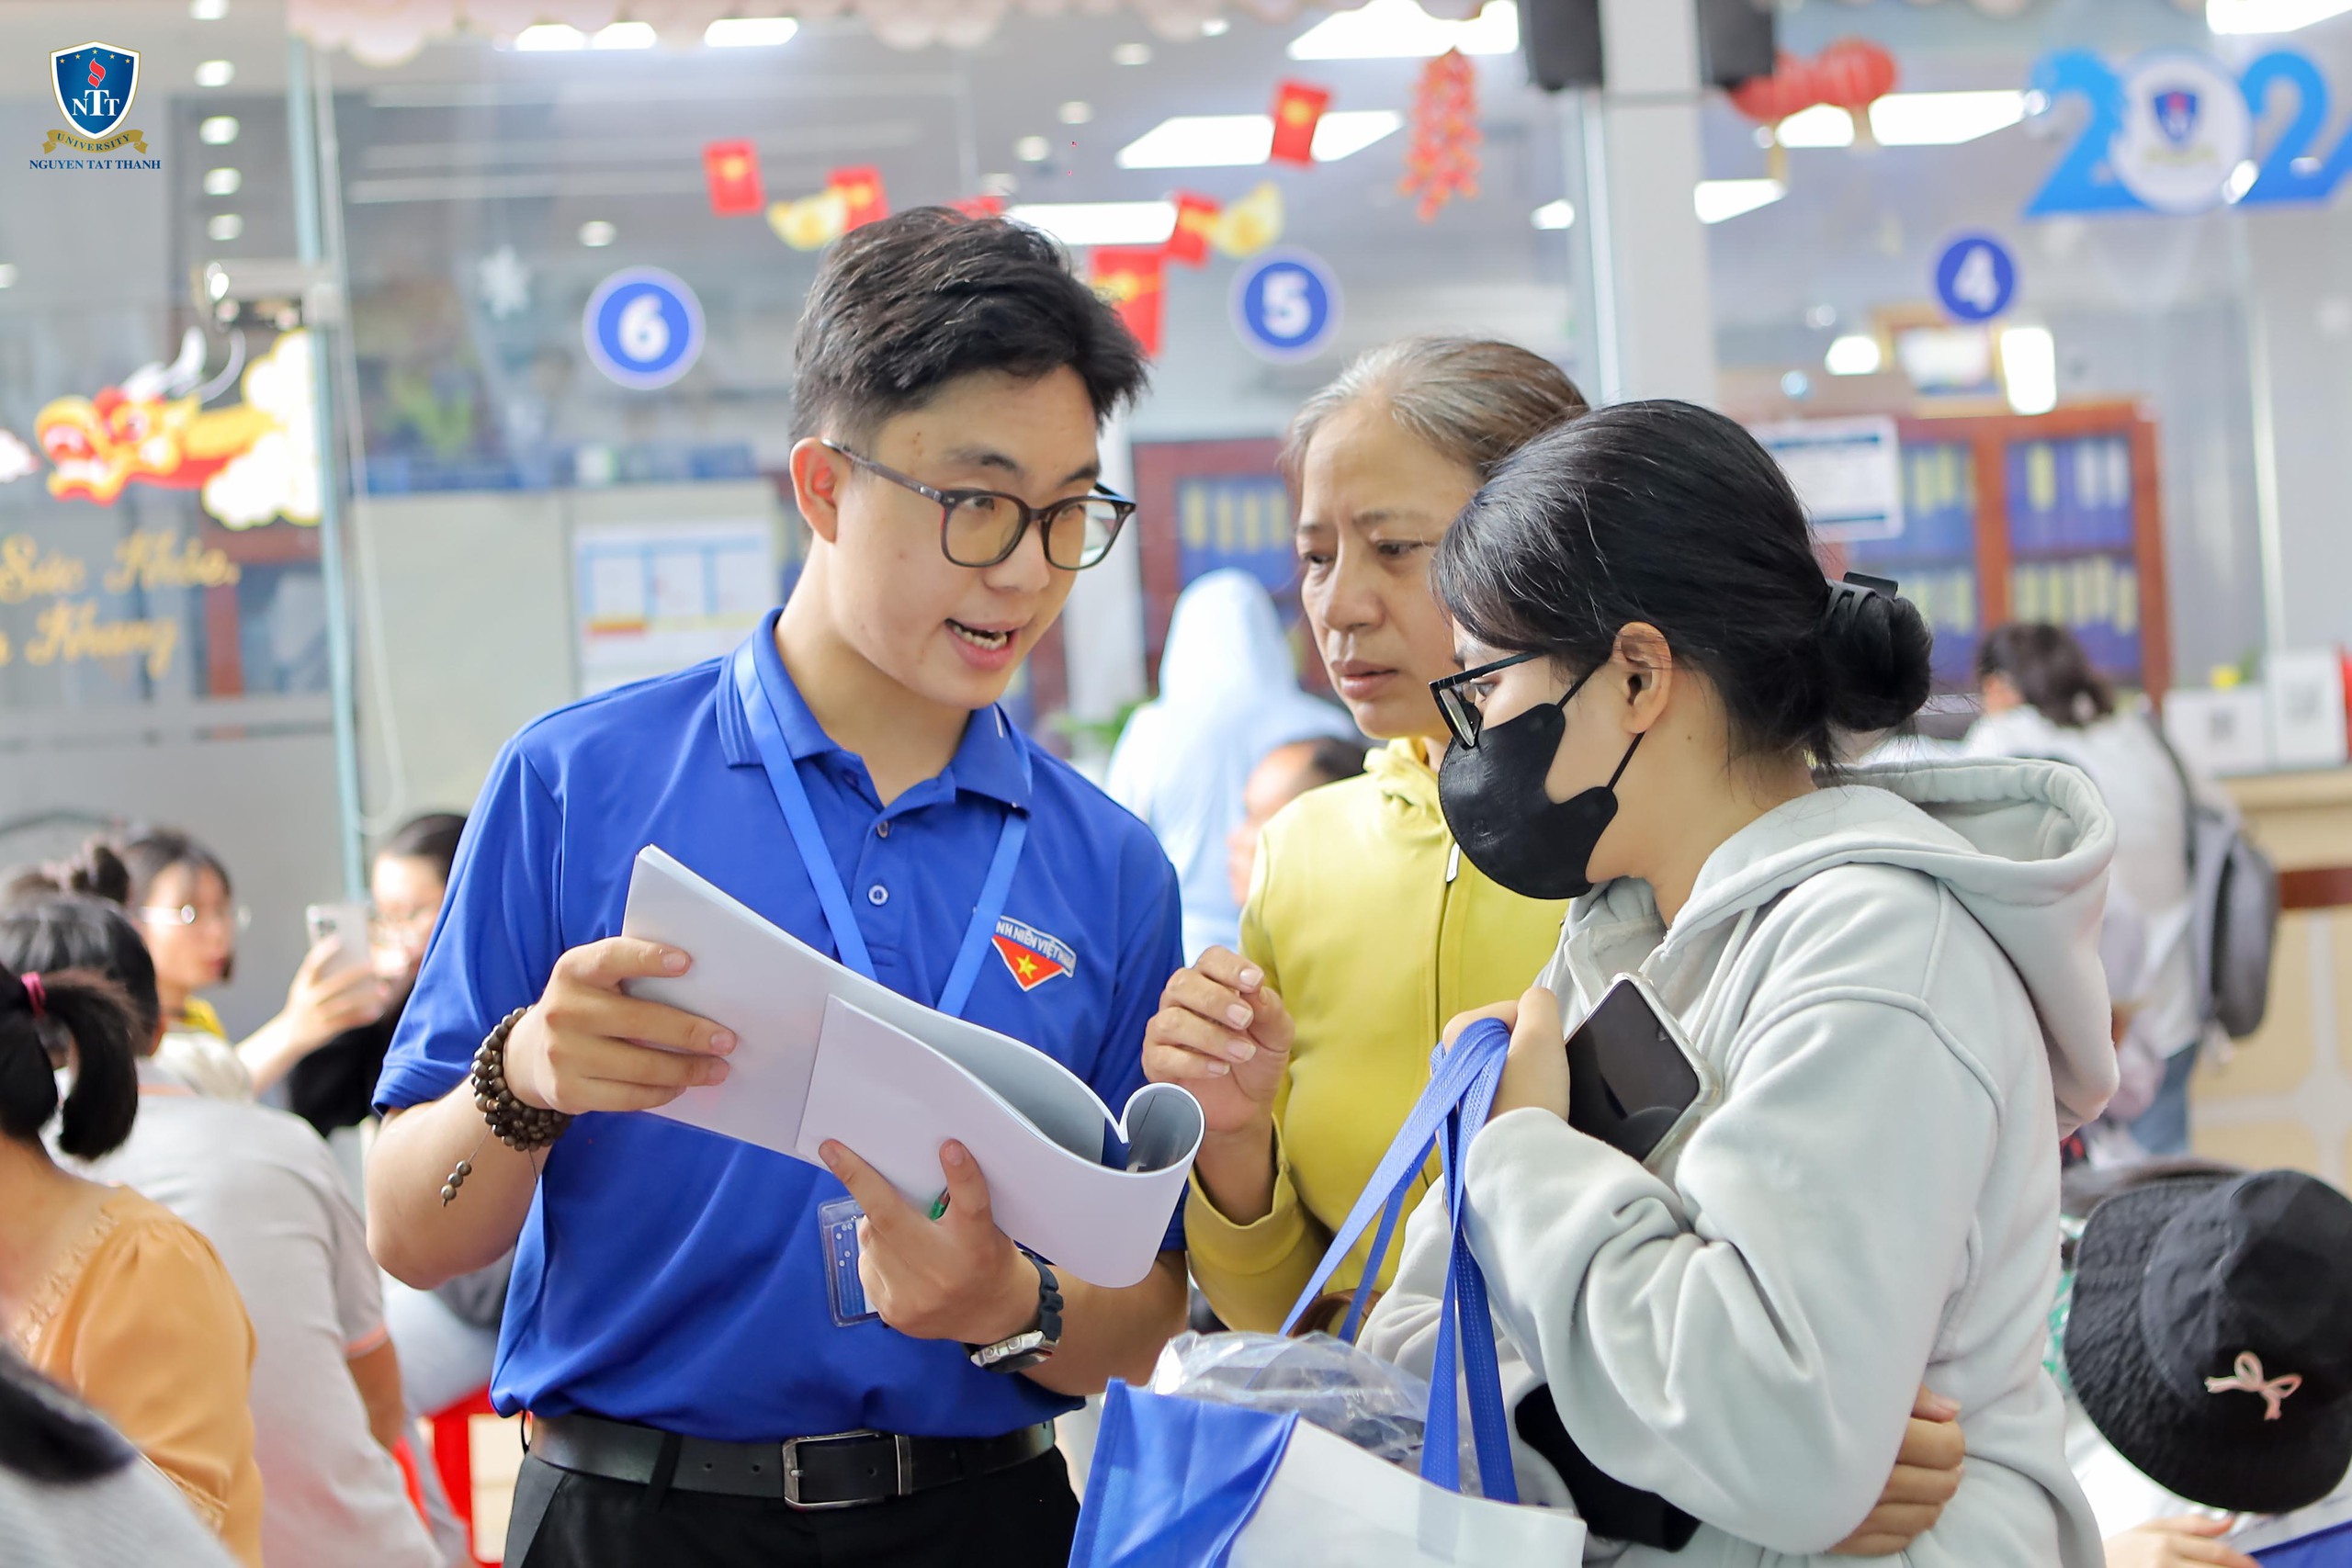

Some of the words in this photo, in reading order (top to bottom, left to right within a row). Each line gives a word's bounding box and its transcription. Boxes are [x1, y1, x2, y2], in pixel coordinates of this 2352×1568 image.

[1261, 270, 1312, 341] 5
[1951, 244, 2000, 312] 4
[616, 292, 671, 364] 6
